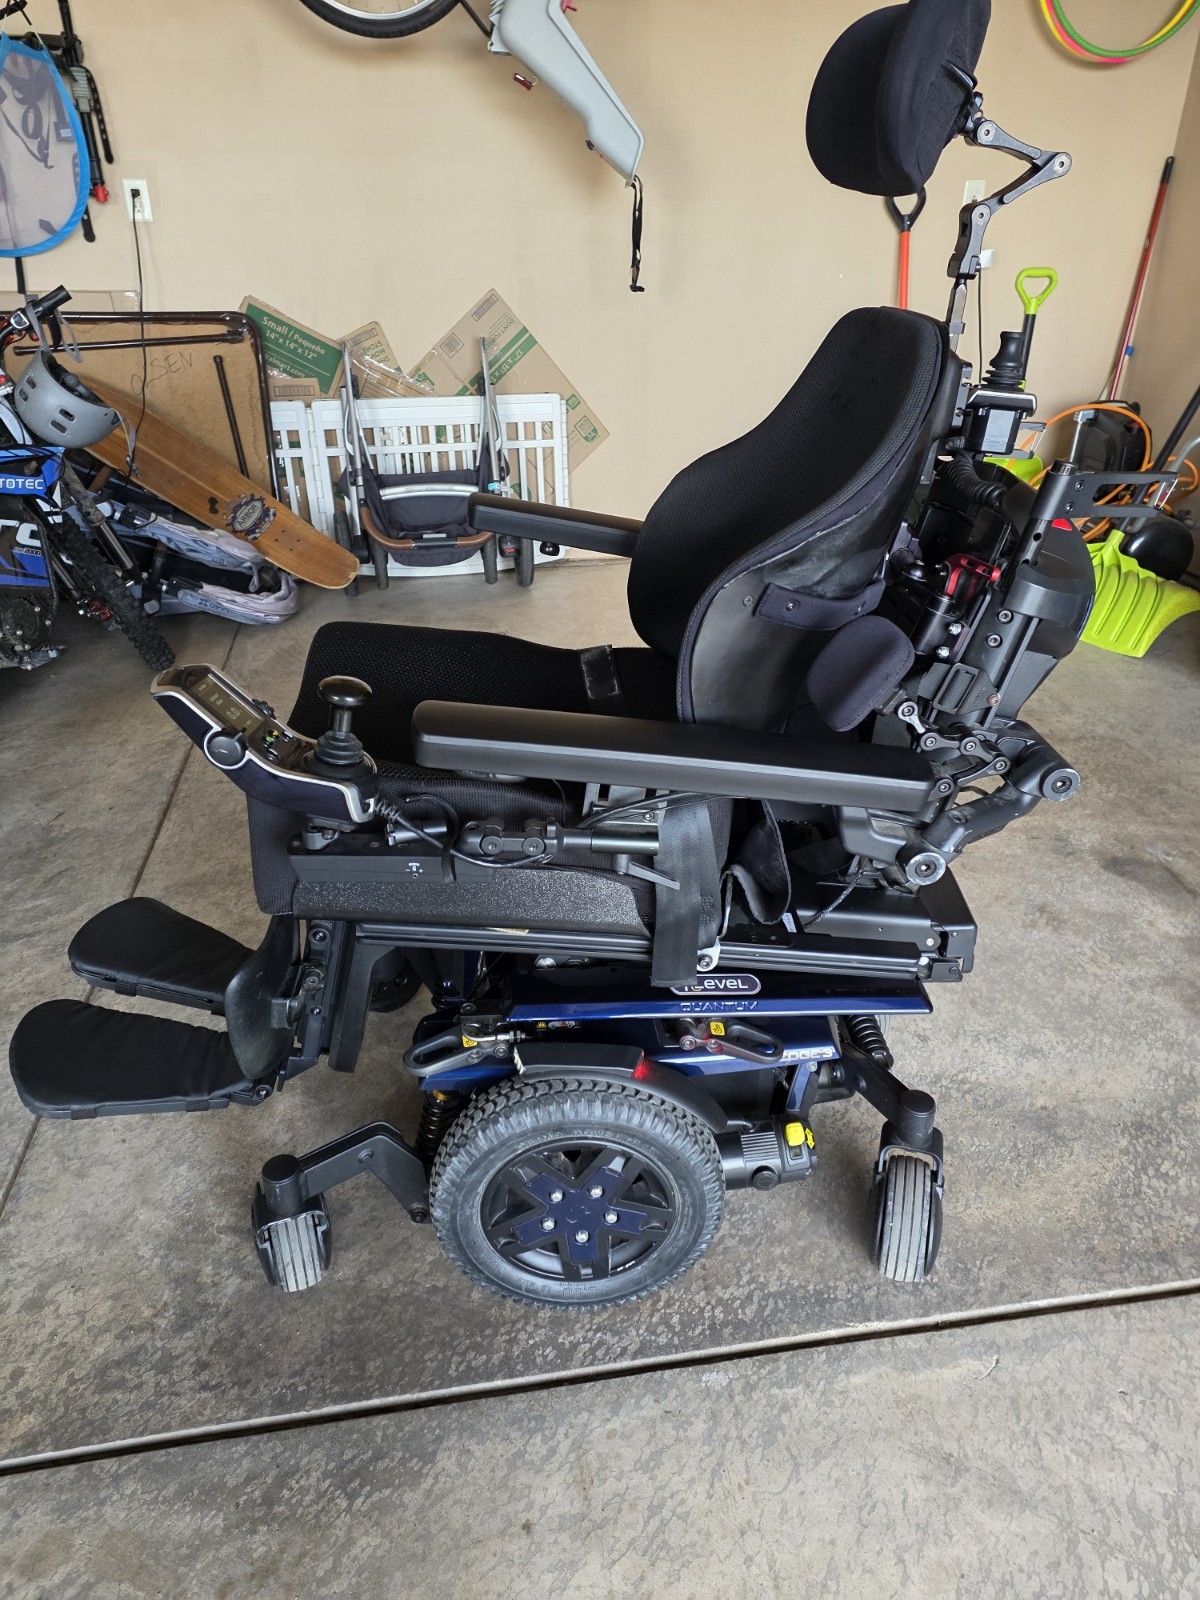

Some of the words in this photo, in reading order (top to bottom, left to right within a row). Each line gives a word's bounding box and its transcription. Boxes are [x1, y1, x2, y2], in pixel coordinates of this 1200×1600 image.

[262, 316, 288, 336] Small
[293, 333, 326, 355] Pequeño
[369, 348, 386, 359] MOV
[131, 351, 192, 396] OLSEN
[238, 503, 258, 527] ARBOR
[680, 1001, 758, 1011] QUANTUM
